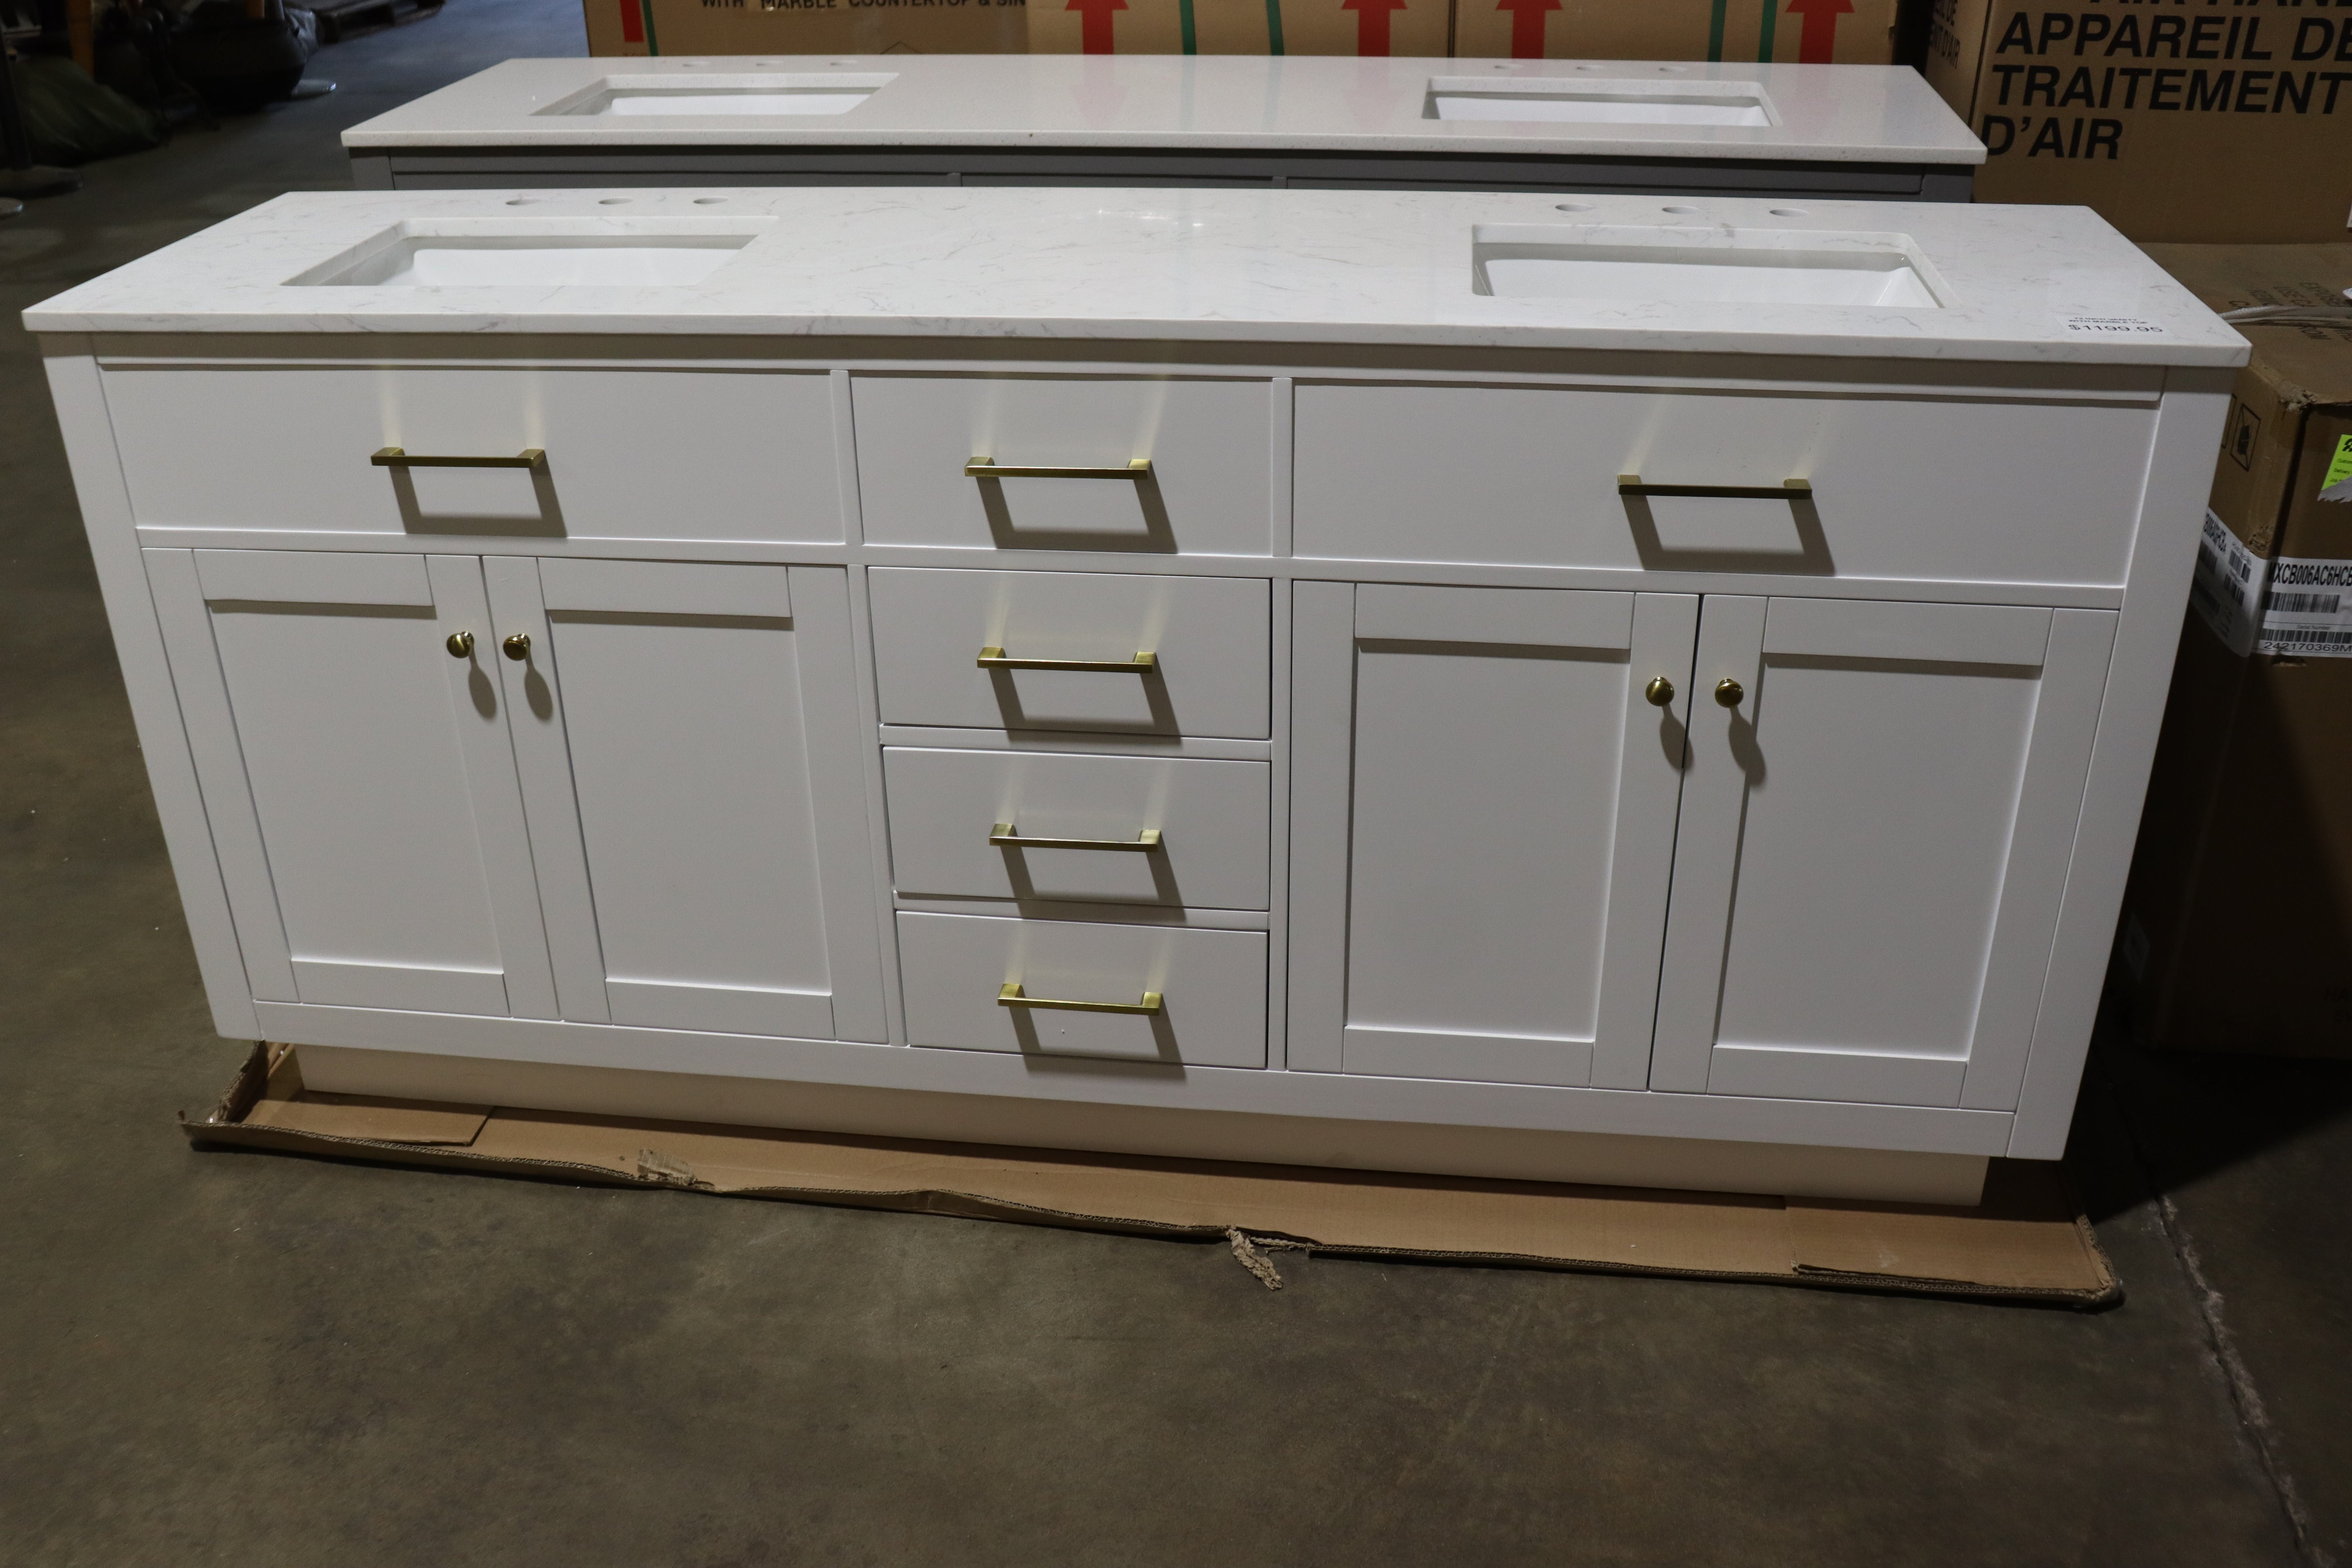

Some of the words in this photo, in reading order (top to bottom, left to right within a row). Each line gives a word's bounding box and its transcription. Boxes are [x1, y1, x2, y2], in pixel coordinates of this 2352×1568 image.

[1996, 12, 2272, 60] APPAREIL
[1992, 64, 2352, 114] TRAITEMENT
[1982, 115, 2123, 159] D'AIR
